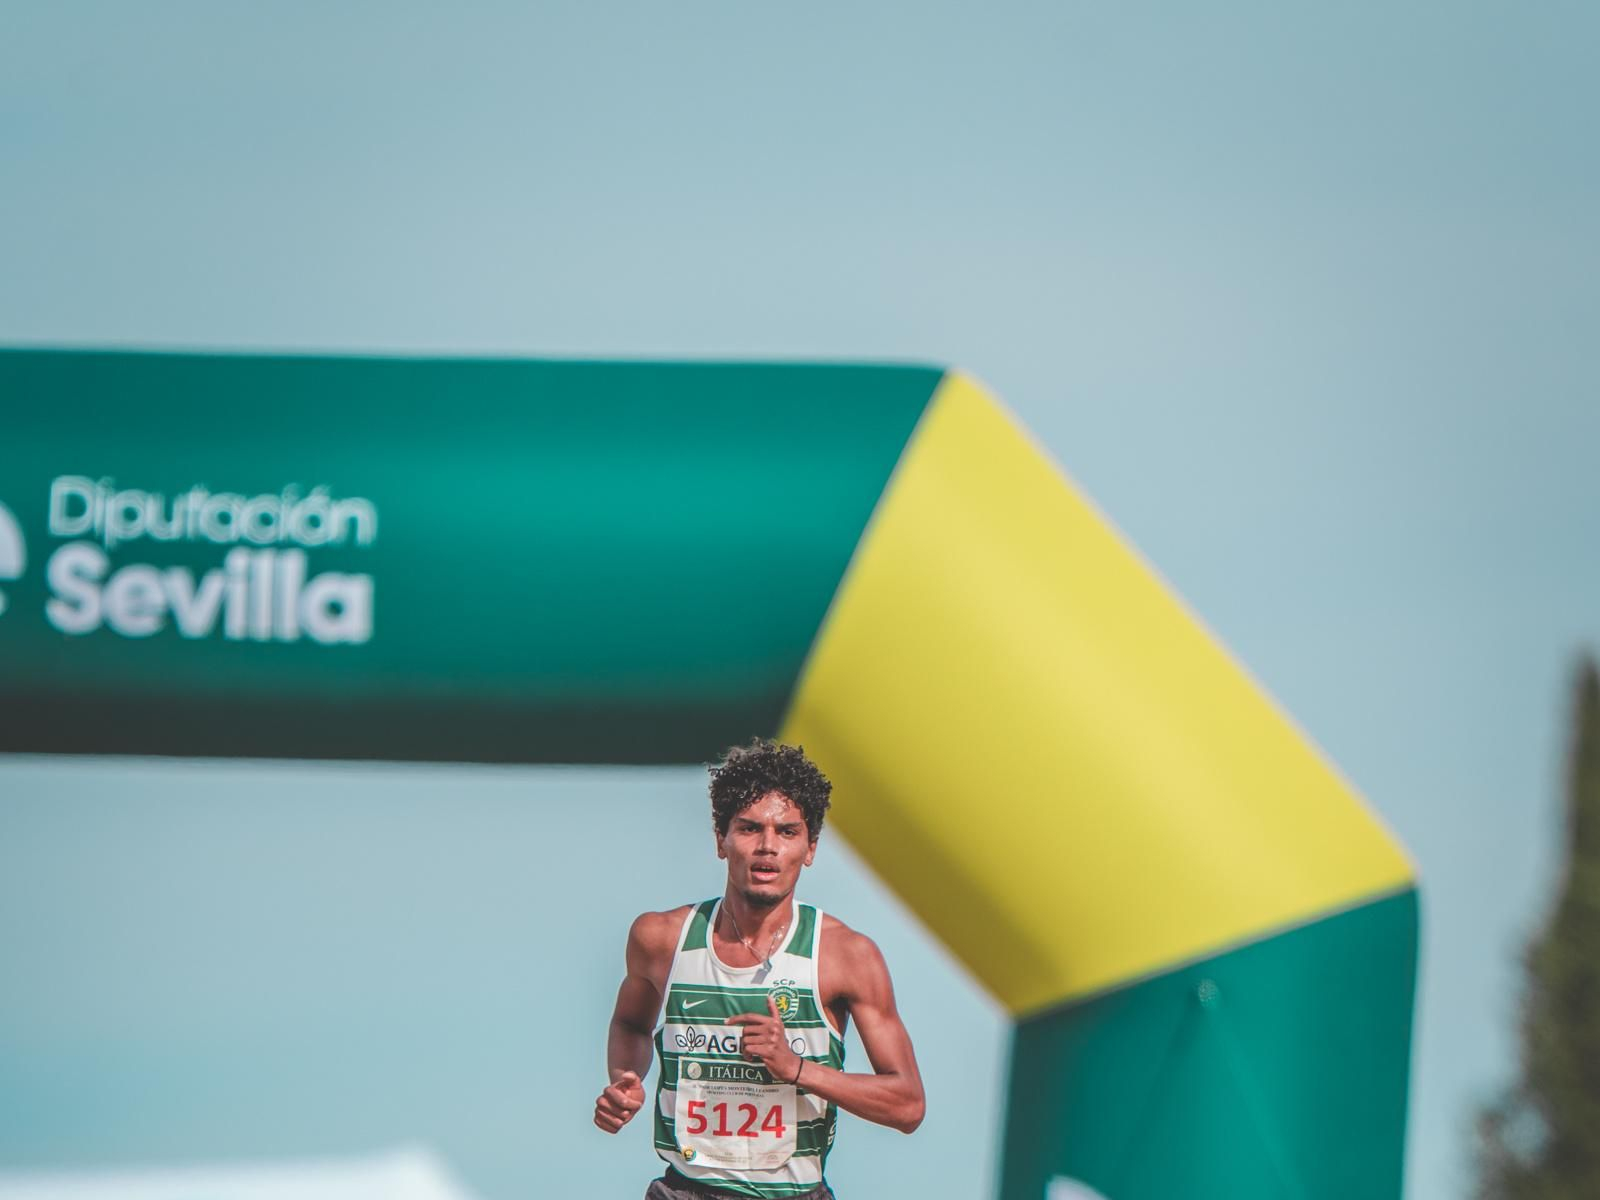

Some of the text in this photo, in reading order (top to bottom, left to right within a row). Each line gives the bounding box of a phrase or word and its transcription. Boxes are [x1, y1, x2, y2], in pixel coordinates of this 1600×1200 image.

[48, 474, 379, 548] Diputación
[45, 540, 376, 645] Sevilla
[709, 1064, 763, 1081] ITÁLICA
[686, 1100, 786, 1139] 5124
